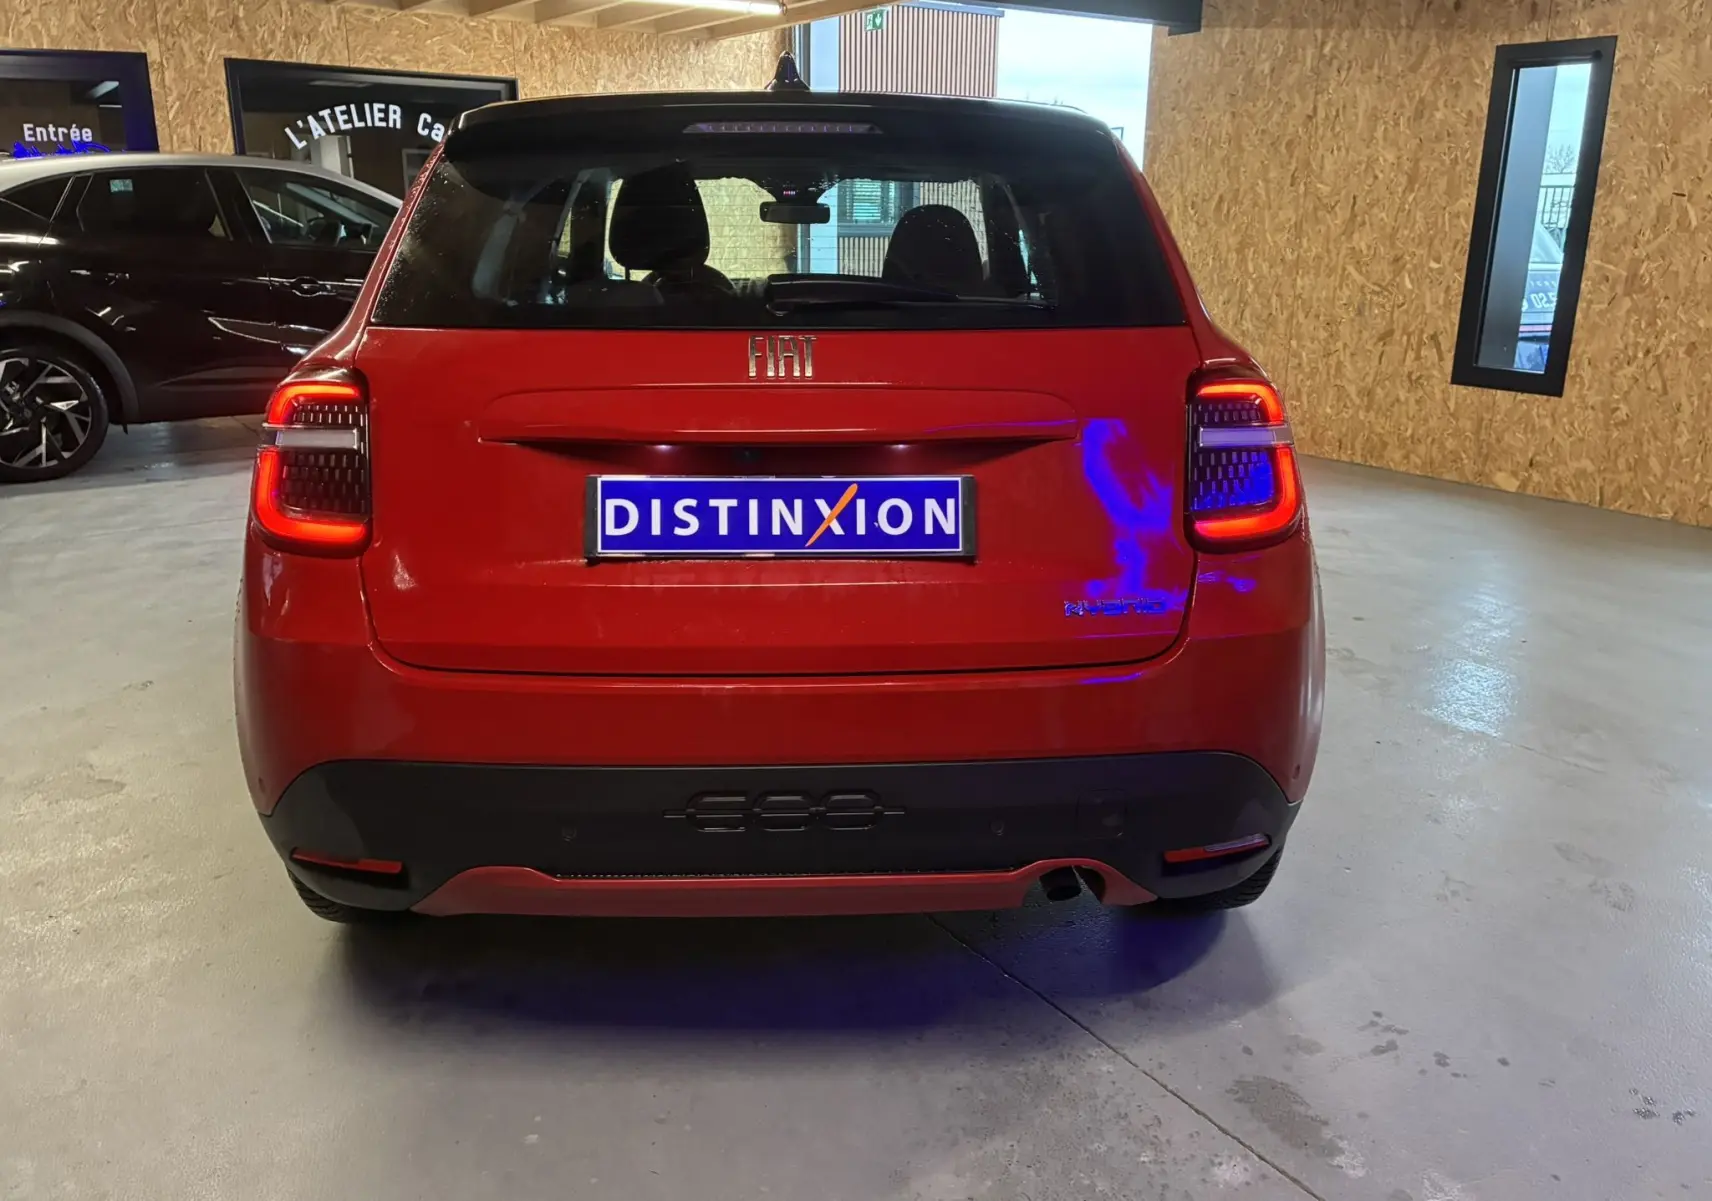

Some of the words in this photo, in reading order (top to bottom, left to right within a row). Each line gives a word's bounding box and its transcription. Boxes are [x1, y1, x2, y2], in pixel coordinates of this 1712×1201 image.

[23, 123, 93, 142] Entrée
[284, 102, 401, 150] L'ATELIER
[417, 112, 446, 143] Ca
[748, 334, 817, 379] FIAT
[604, 483, 955, 547] DISTINXION
